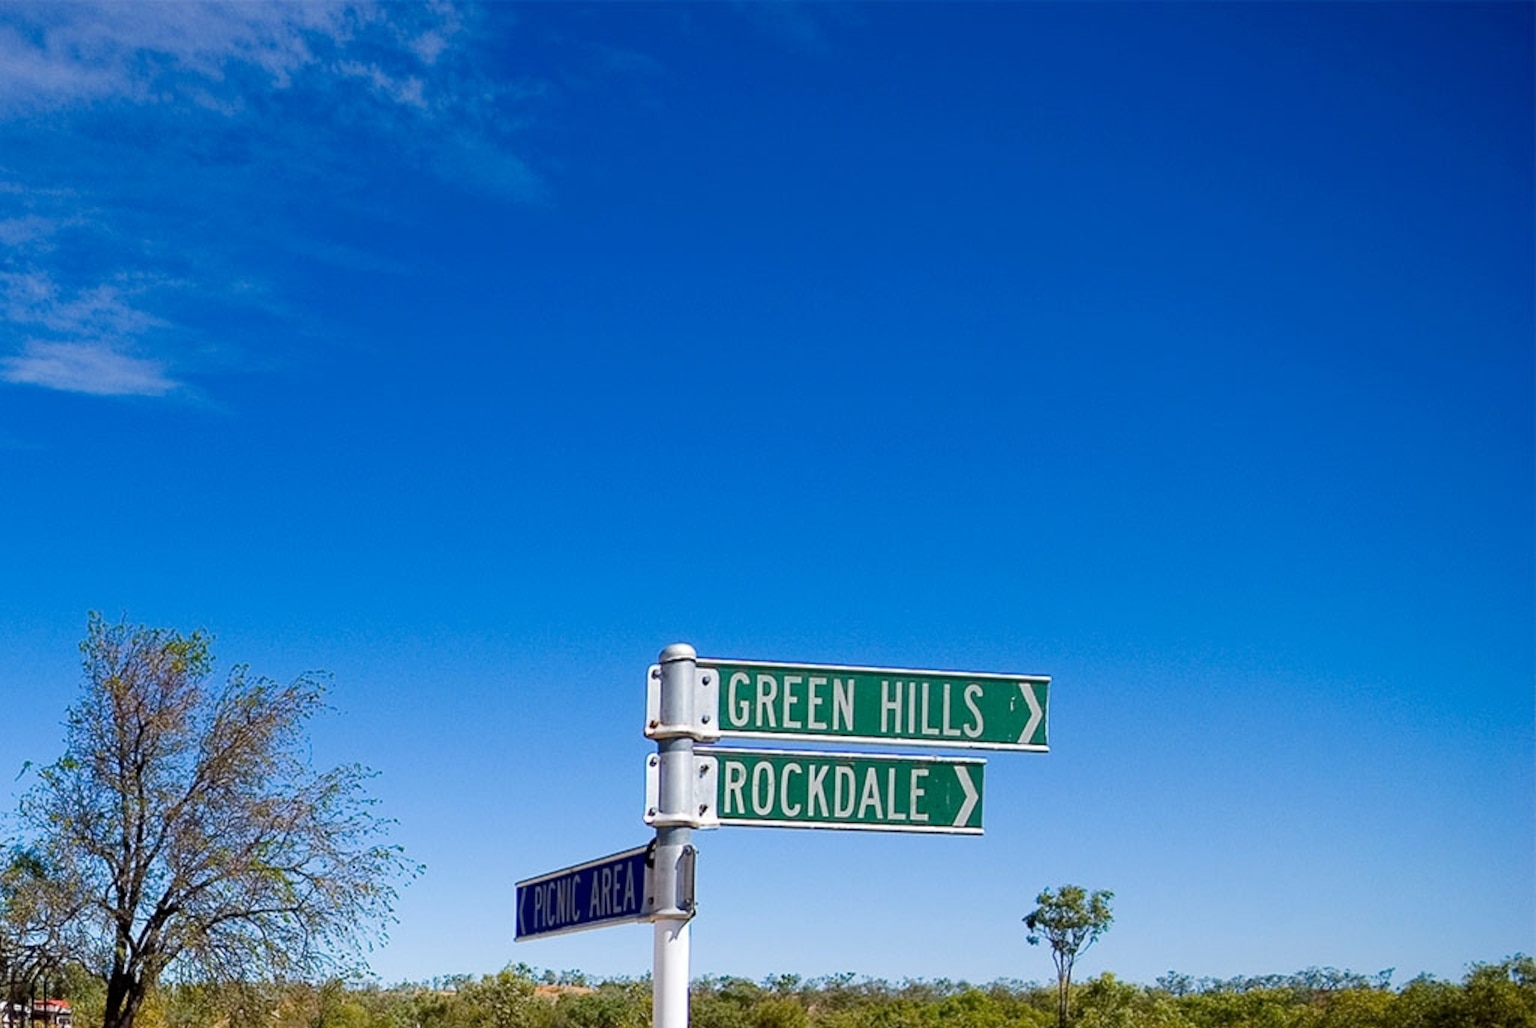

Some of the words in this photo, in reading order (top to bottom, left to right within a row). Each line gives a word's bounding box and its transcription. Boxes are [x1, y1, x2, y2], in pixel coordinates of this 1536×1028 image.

[727, 672, 855, 731] GREEN
[881, 680, 984, 738] HILLS
[724, 761, 930, 821] ROCKDALE
[533, 874, 582, 929] PICNIC
[588, 861, 636, 918] AREA
